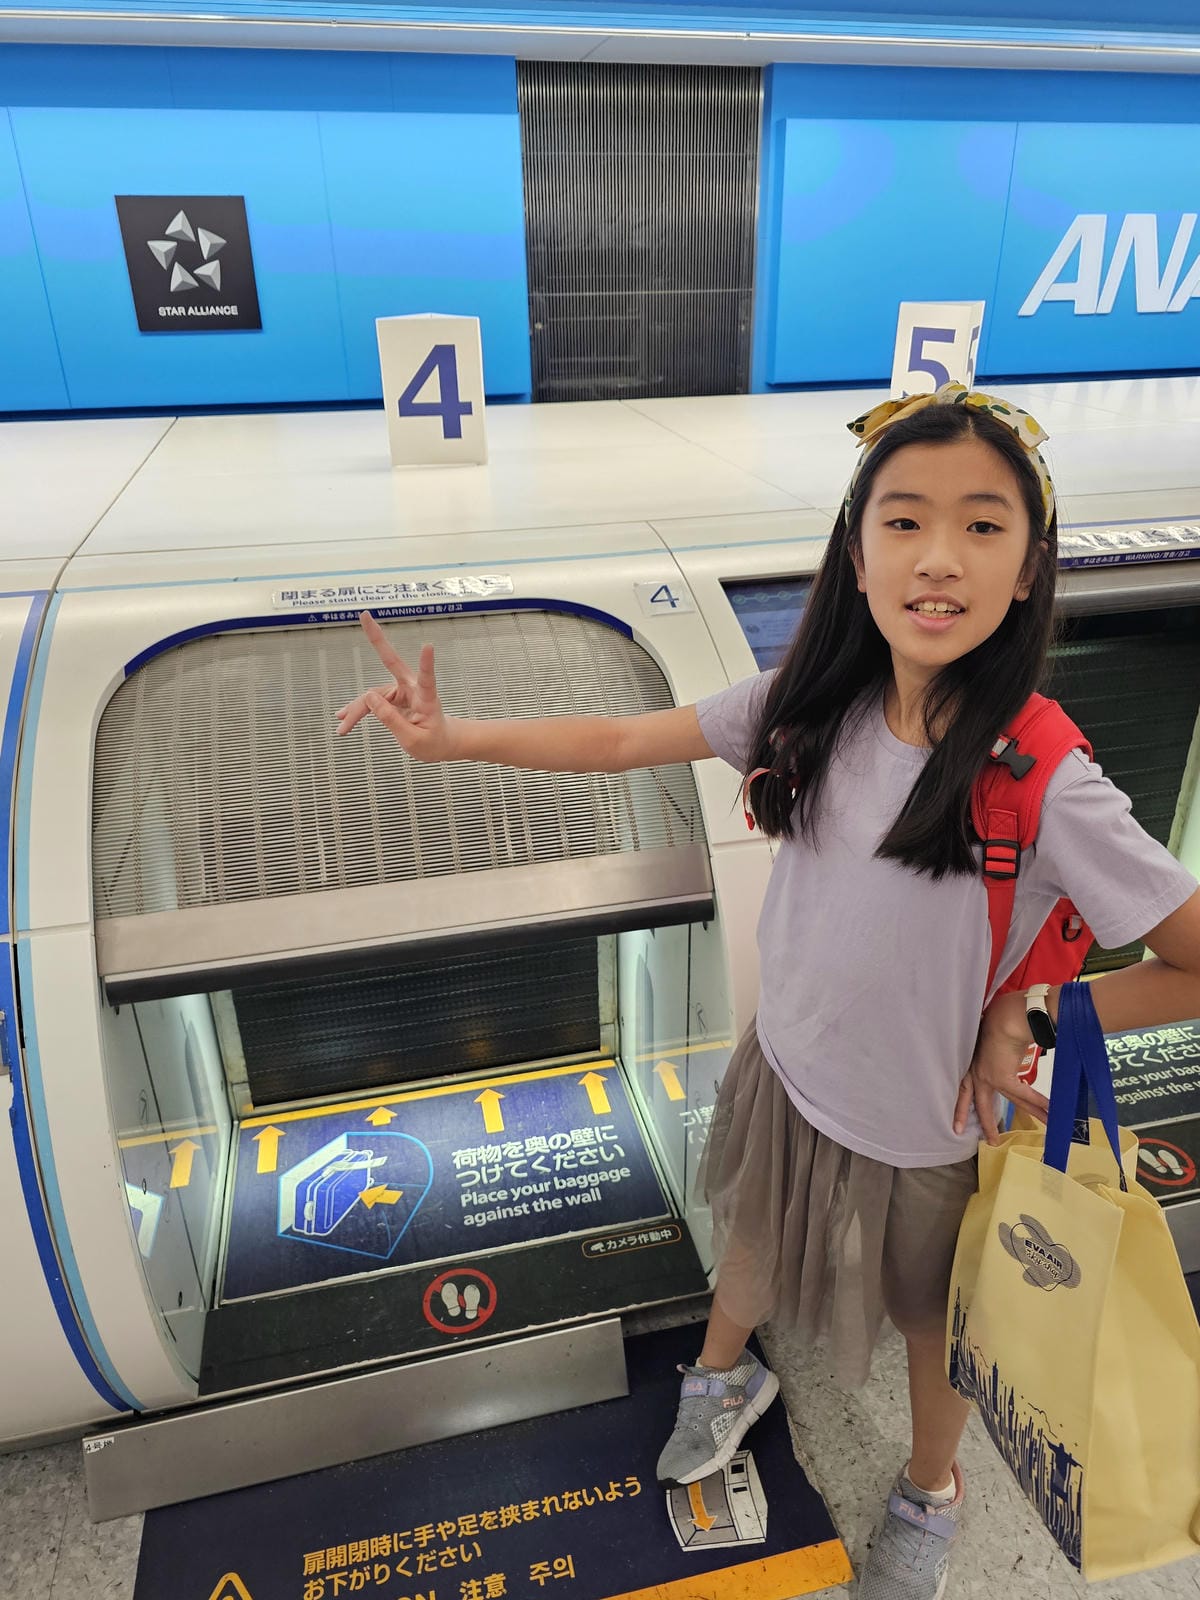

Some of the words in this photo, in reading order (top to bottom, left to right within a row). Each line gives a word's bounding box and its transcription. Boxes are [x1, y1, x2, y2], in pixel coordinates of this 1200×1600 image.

[158, 306, 186, 316] STAR
[187, 305, 238, 316] ALLIANCE
[908, 326, 956, 397] 5
[398, 344, 472, 439] 4
[292, 599, 326, 607] Please
[329, 596, 357, 604] stand
[360, 594, 384, 602] clear
[650, 585, 679, 608] 4
[1112, 1075, 1140, 1088] ace
[1138, 1069, 1173, 1085] your
[1114, 1087, 1170, 1105] against
[1166, 1082, 1195, 1094] the
[452, 1125, 619, 1169] 荷物を奥の壁に
[455, 1143, 626, 1188] つけてください
[460, 1188, 508, 1208] Place
[511, 1181, 551, 1201] your
[553, 1167, 631, 1190] baggage
[463, 1203, 530, 1227] against
[531, 1197, 563, 1213] the
[565, 1187, 602, 1207] wall
[607, 1229, 673, 1250] カメラ作動中
[1025, 1239, 1046, 1257] EVA
[1046, 1254, 1063, 1270] AIR
[685, 1382, 704, 1393] FILA
[723, 1395, 744, 1409] FILA
[303, 1476, 642, 1576] 扉開閉時に手や足を挟まれないよう
[899, 1502, 928, 1525] FILA
[303, 1541, 482, 1600] お下がりください
[459, 1572, 507, 1600] 注意
[529, 1554, 577, 1587] 주의
